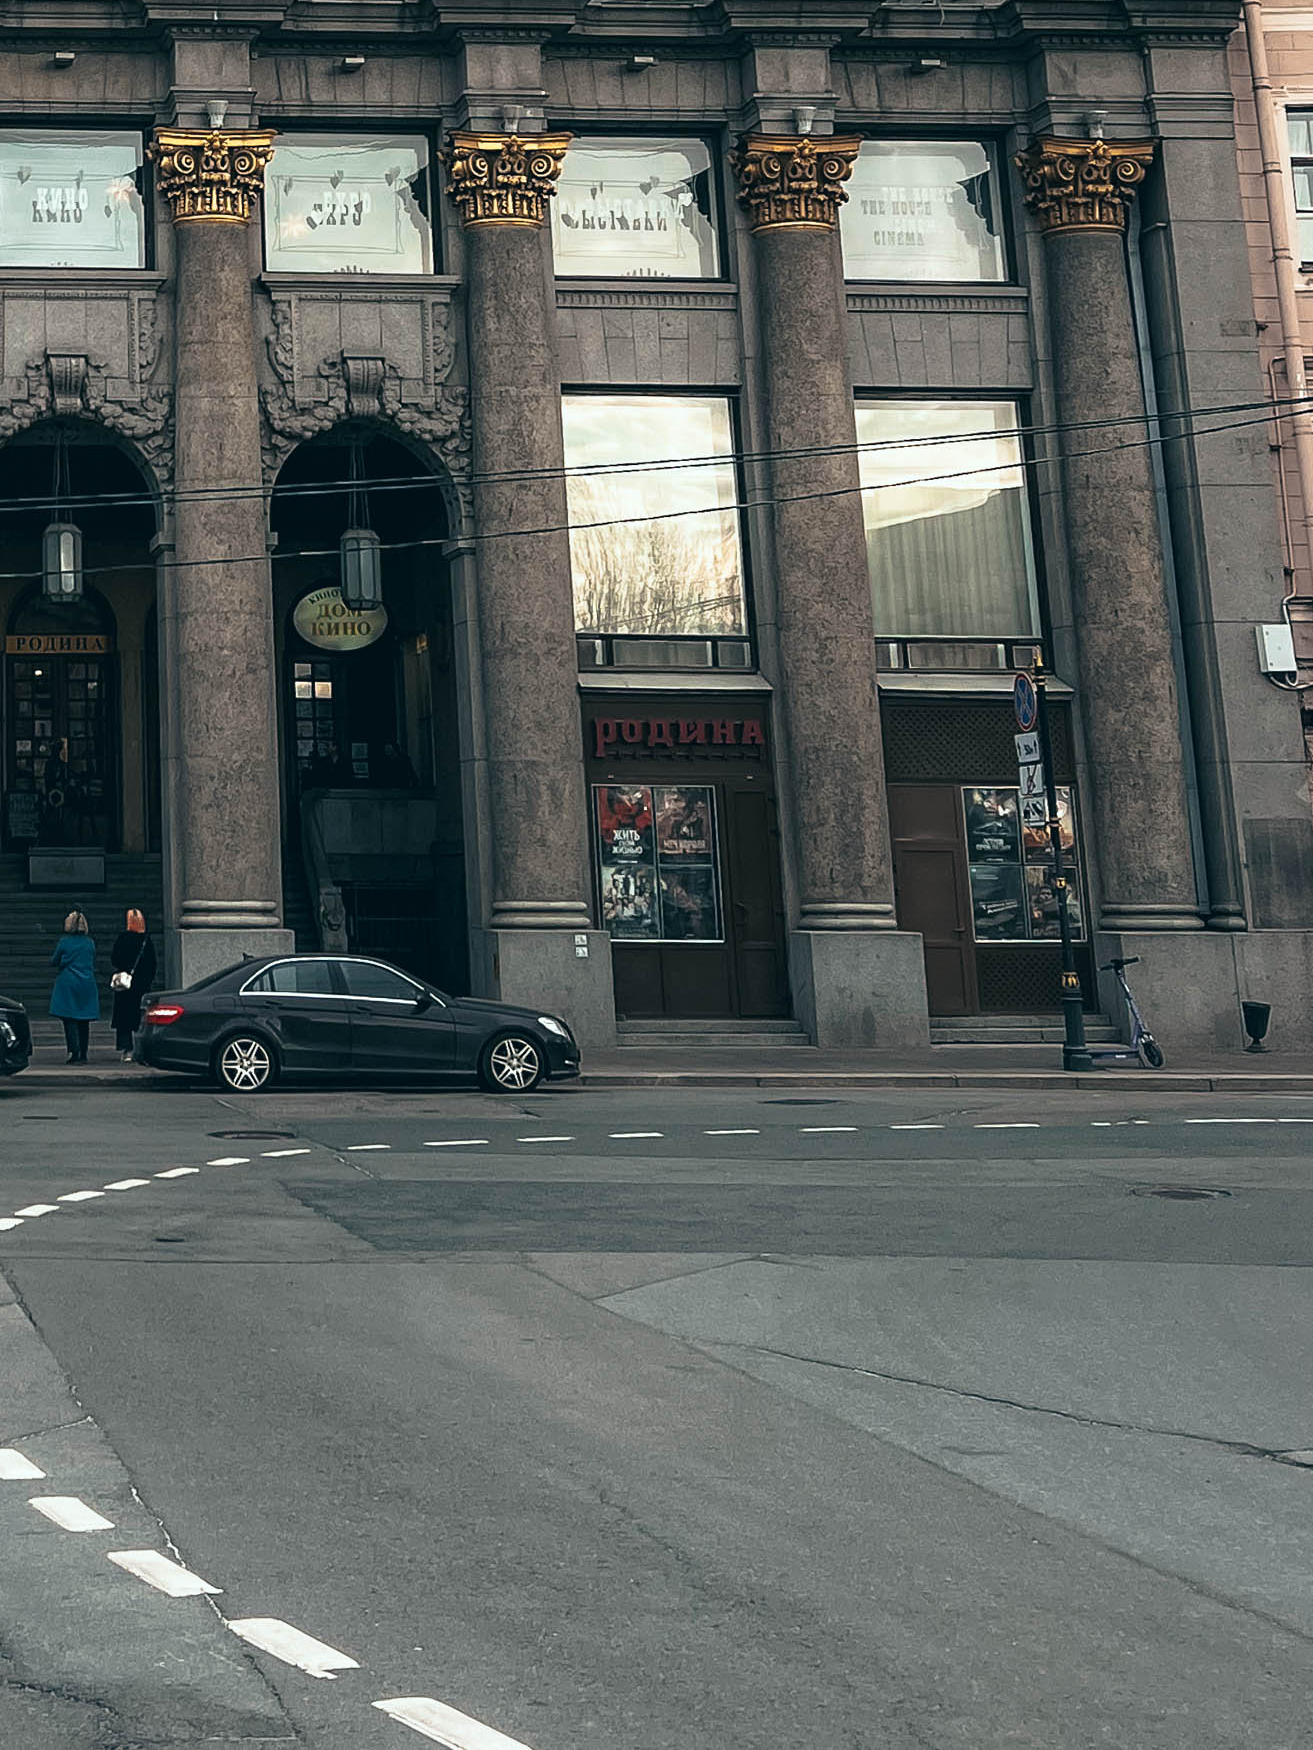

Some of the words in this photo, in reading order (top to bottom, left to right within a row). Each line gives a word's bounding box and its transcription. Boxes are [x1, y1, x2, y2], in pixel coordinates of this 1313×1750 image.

[34, 187, 89, 212] КИНО
[310, 621, 372, 637] КИНО
[15, 636, 106, 652] РОДИНА
[595, 719, 765, 757] РОДИНА
